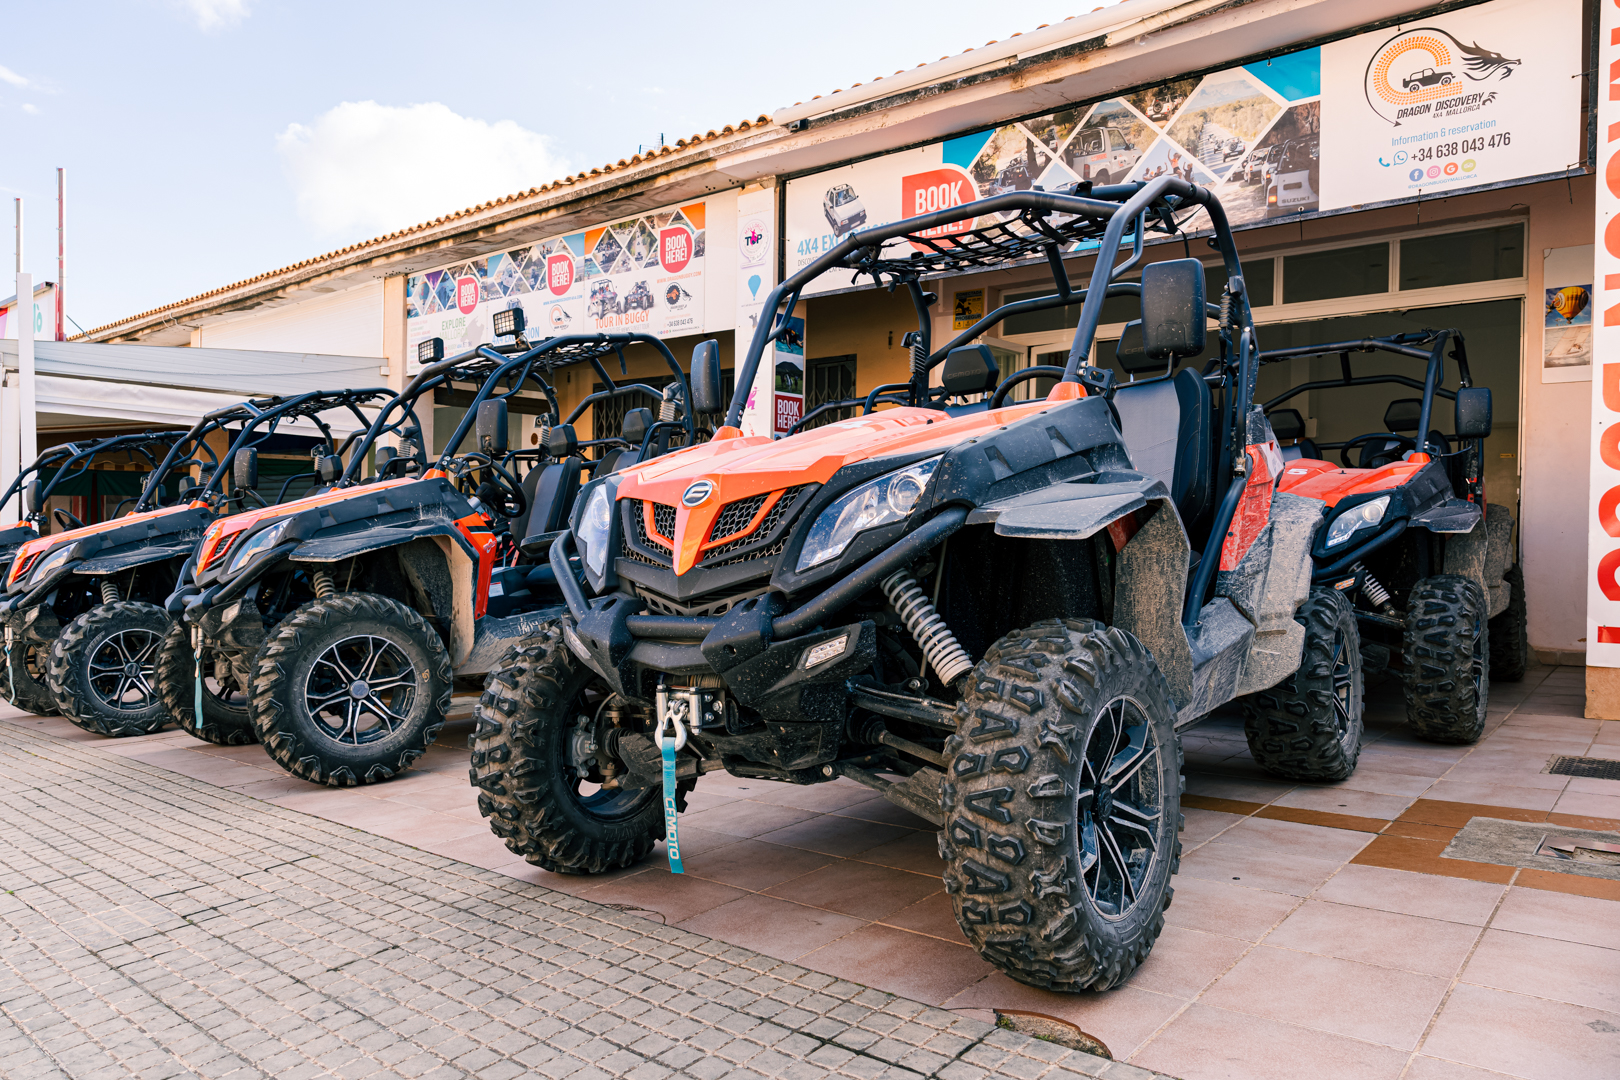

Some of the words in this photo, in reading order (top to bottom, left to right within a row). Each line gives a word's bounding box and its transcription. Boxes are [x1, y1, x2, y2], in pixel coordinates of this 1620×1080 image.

[1397, 103, 1432, 119] DRAGON
[1435, 91, 1485, 112] DISCOVERY
[1445, 103, 1481, 117] MALLORCA
[1391, 129, 1439, 147] Information
[1440, 127, 1446, 137] &
[1448, 119, 1497, 136] reservation
[1410, 146, 1433, 162] +34
[1436, 141, 1458, 158] 638
[1461, 136, 1485, 154] 043
[1488, 131, 1511, 149] 476
[915, 179, 963, 215] BOOK
[1281, 196, 1310, 204] SUZUKI
[665, 233, 688, 252] BOOK
[797, 236, 819, 256] 4X4
[665, 247, 688, 265] HERE!
[551, 260, 570, 276] BOOK
[551, 272, 570, 288] HERE!
[460, 282, 476, 297] BOOK
[460, 294, 476, 308] HERE!
[441, 316, 467, 331] EXPLORE
[595, 315, 614, 330] TOUR
[615, 314, 623, 326] IN
[624, 309, 650, 325] BUGGY
[440, 327, 469, 341] MALLORCA
[947, 368, 982, 380] CFMOTO
[777, 399, 800, 417] BOOK
[665, 797, 680, 860] CFMOTO
